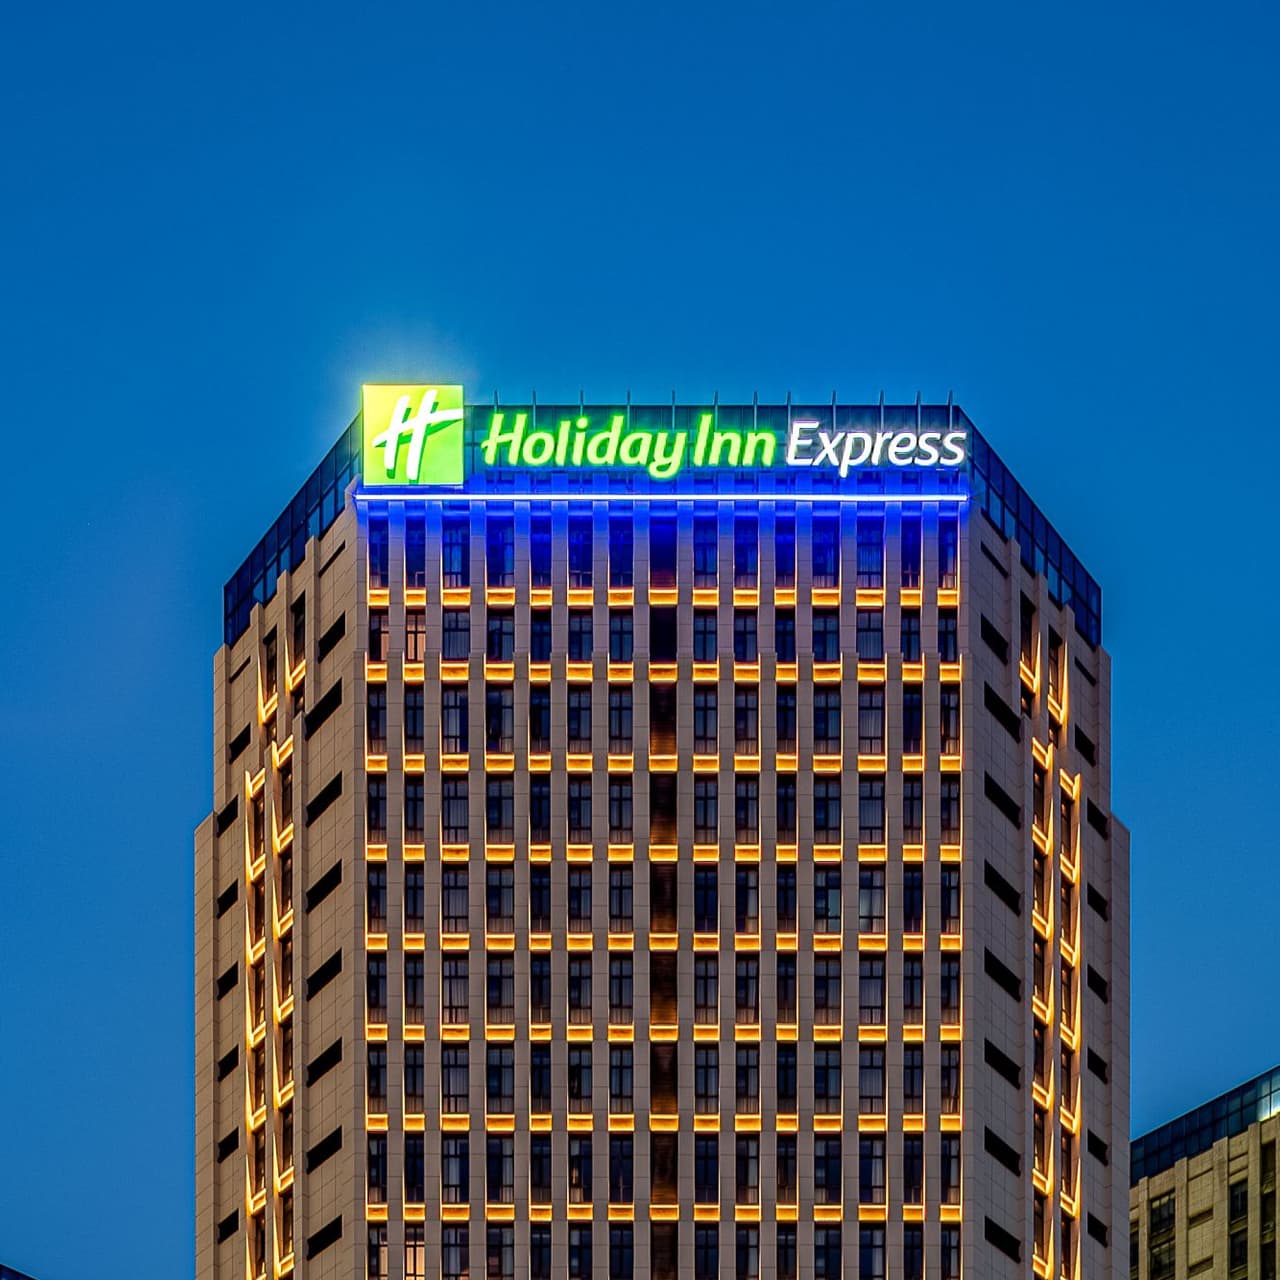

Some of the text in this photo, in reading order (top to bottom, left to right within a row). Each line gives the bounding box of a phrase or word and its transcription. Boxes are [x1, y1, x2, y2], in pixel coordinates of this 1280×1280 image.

[482, 413, 967, 480] Holiday Inn Express
